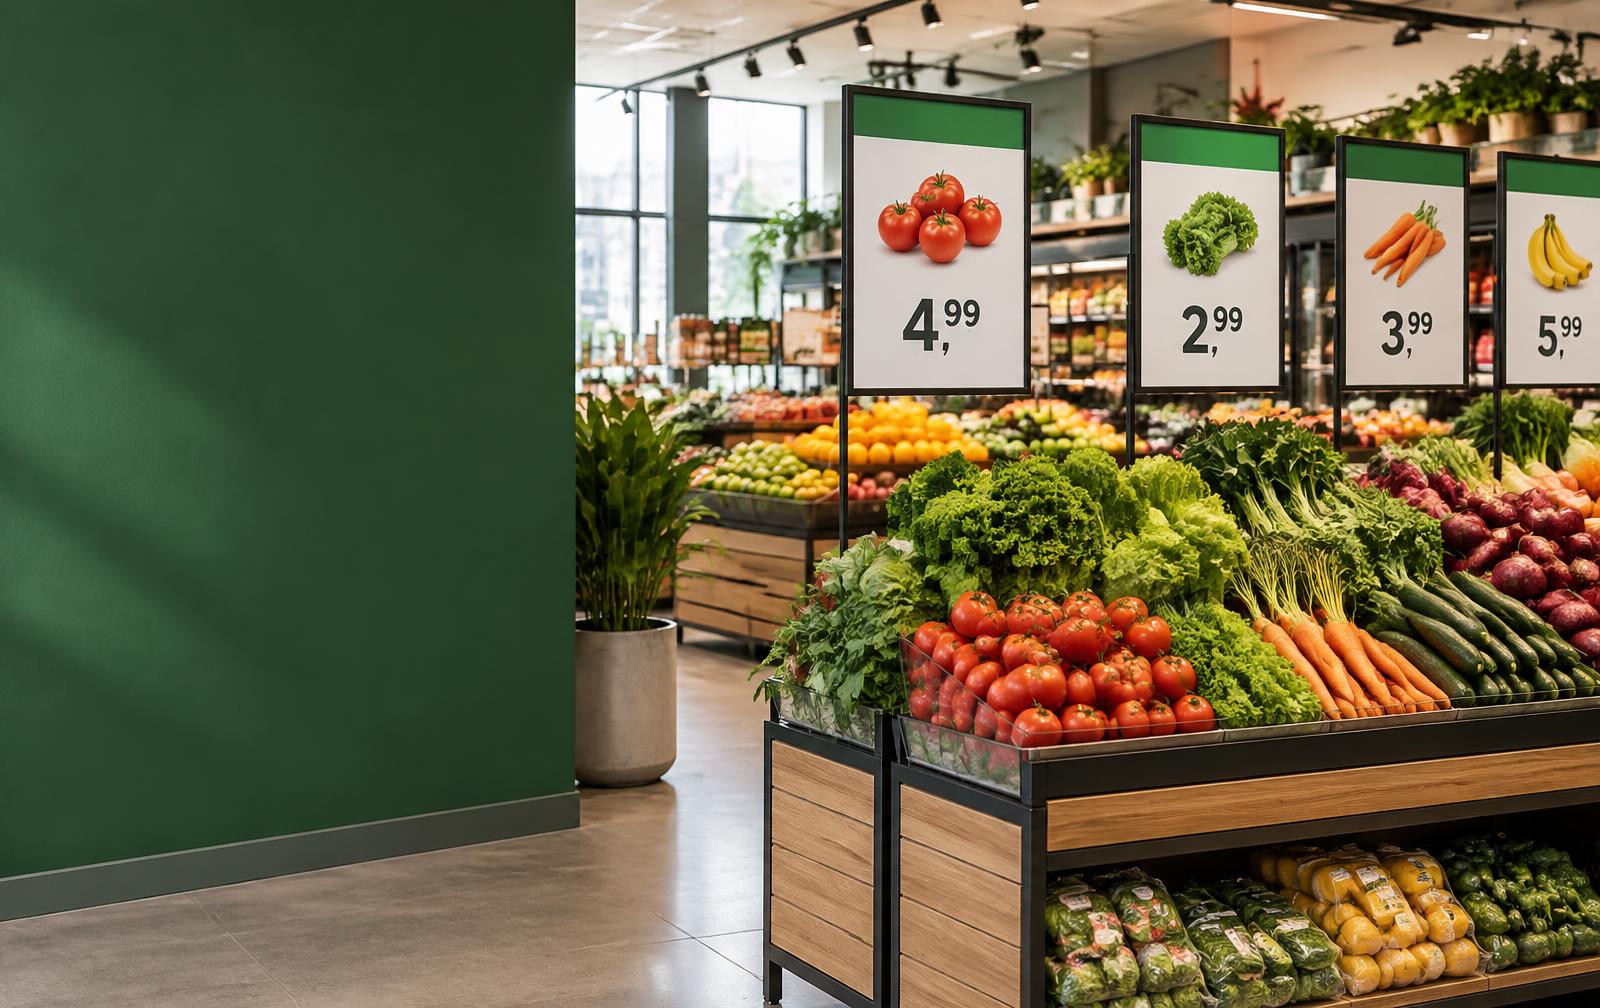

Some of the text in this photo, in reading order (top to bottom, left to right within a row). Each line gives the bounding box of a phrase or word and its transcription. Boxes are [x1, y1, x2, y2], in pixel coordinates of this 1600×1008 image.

[902, 298, 981, 356] 4,99
[1182, 304, 1243, 358] 2,99
[1381, 310, 1433, 359] 3,99
[1537, 315, 1582, 360] 5,99
